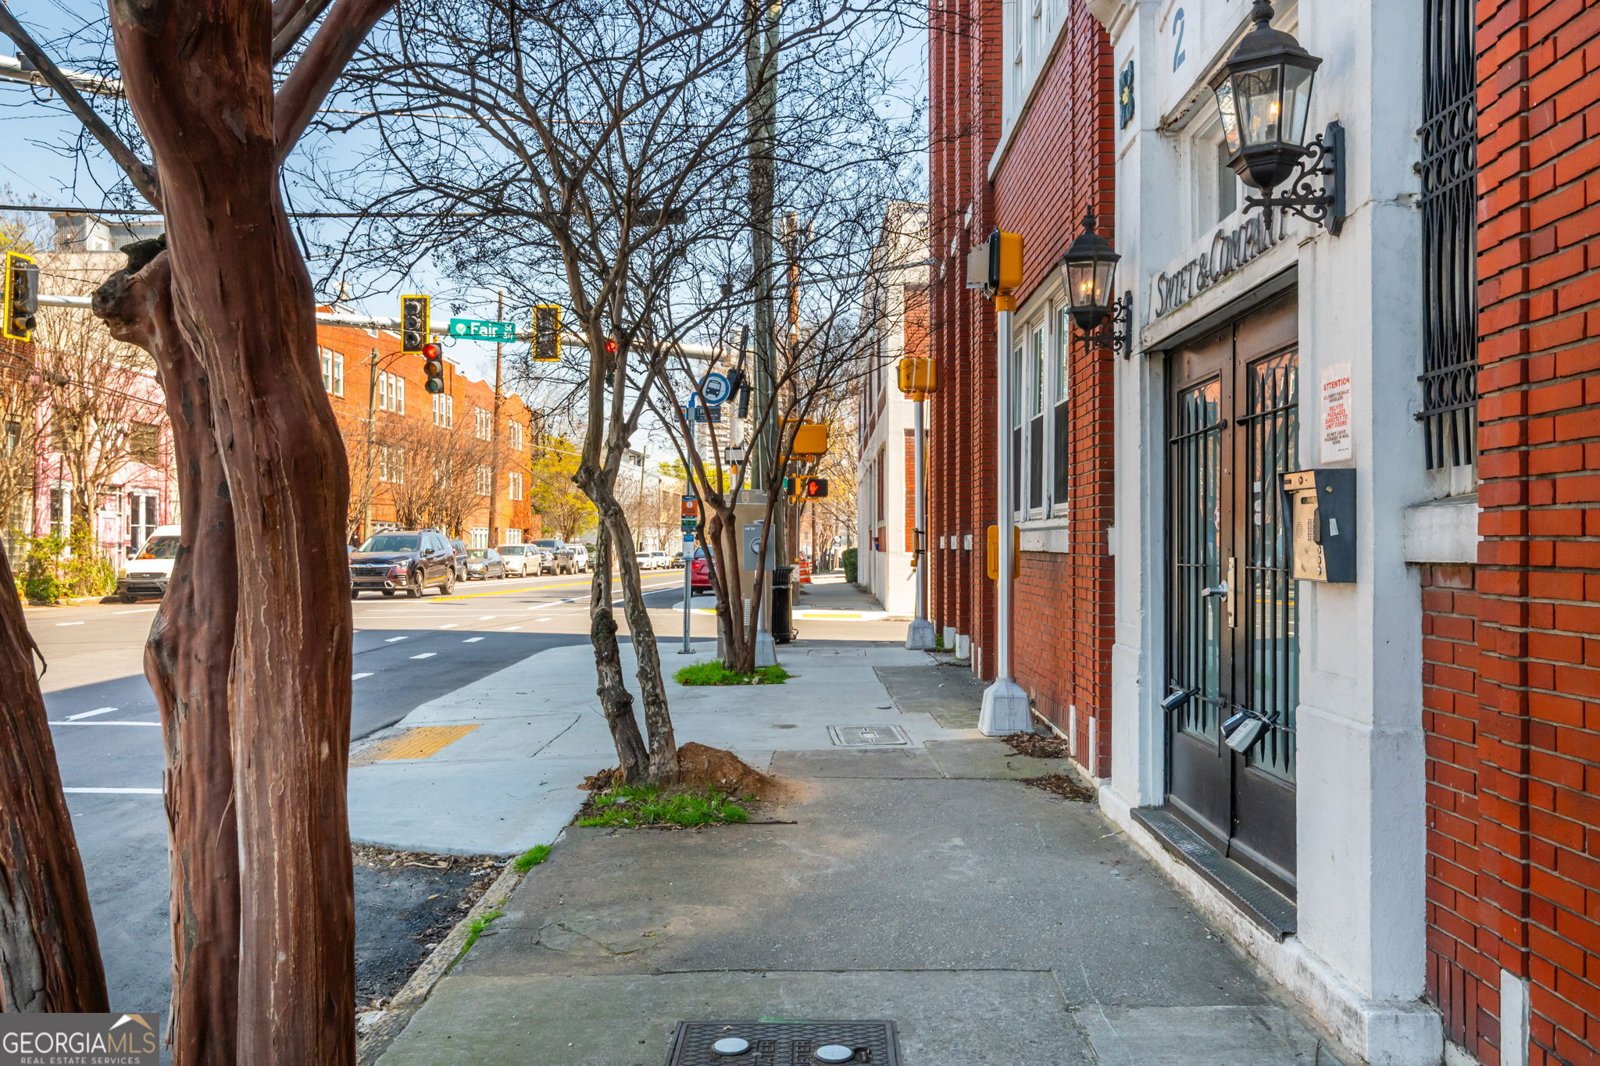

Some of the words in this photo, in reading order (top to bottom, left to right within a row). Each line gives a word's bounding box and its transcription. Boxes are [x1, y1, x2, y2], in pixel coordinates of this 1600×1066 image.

[1172, 7, 1186, 74] 2
[1196, 252, 1210, 292] &
[470, 322, 498, 337] Fair
[1323, 377, 1350, 391] ATTENTION
